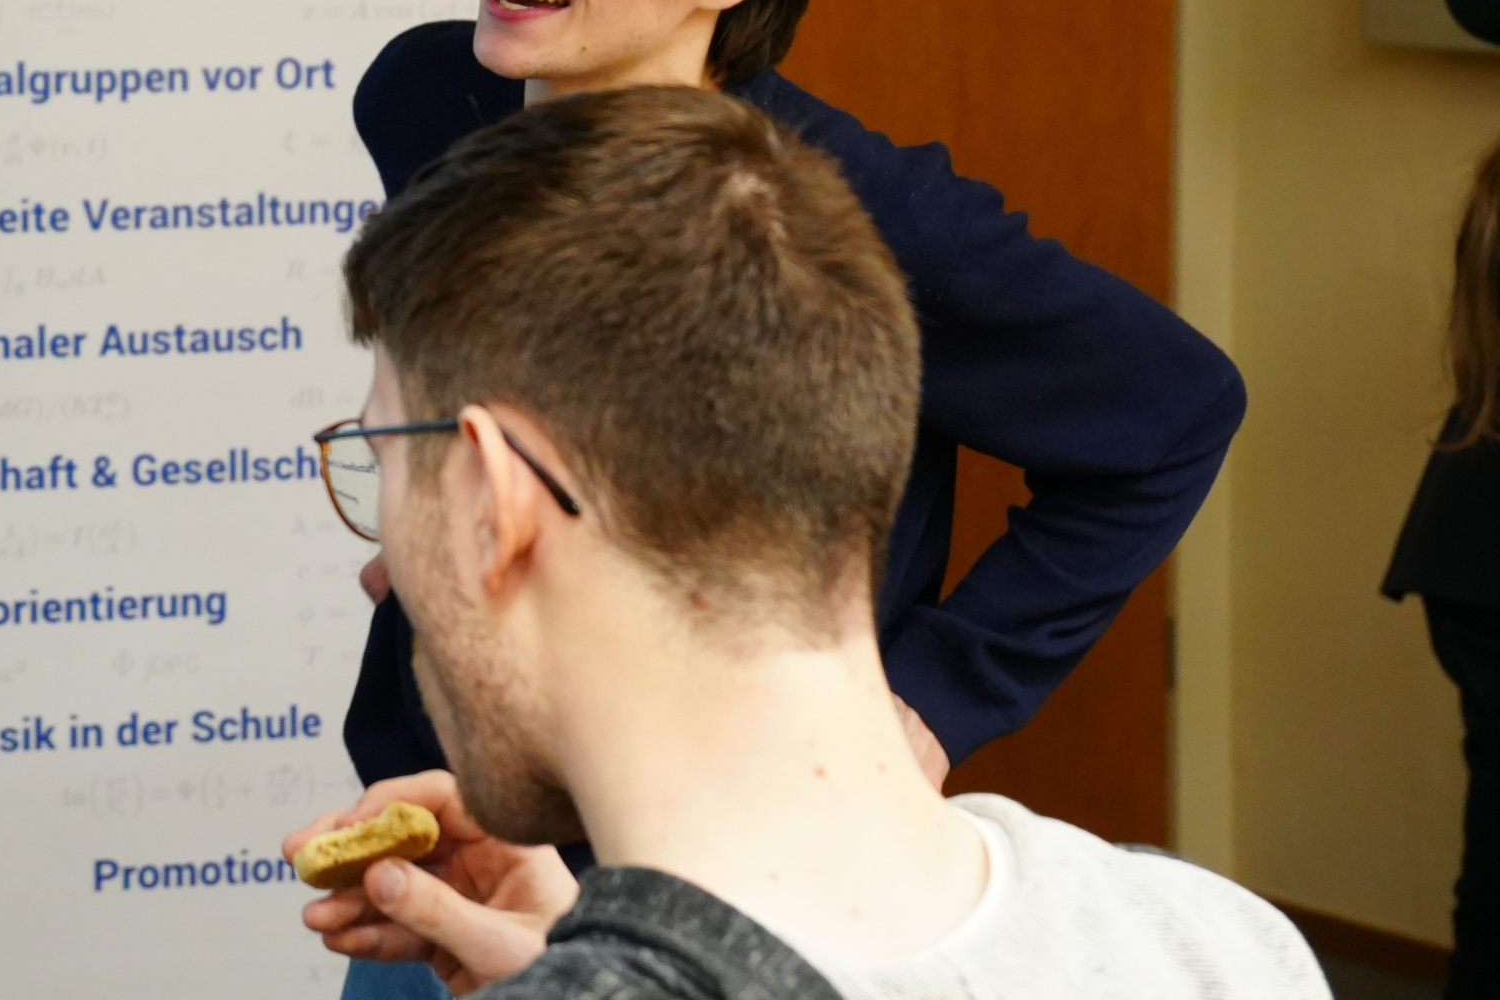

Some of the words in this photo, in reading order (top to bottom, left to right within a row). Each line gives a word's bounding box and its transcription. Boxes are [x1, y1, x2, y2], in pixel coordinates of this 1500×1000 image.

[202, 65, 263, 94] vor
[275, 56, 336, 91] Ort
[99, 316, 303, 358] Austausch
[91, 455, 118, 489] &
[131, 446, 324, 488] Gesellsch
[69, 713, 104, 750] in
[116, 712, 179, 749] der
[191, 704, 324, 745] Schule
[93, 849, 298, 892] Promotion
